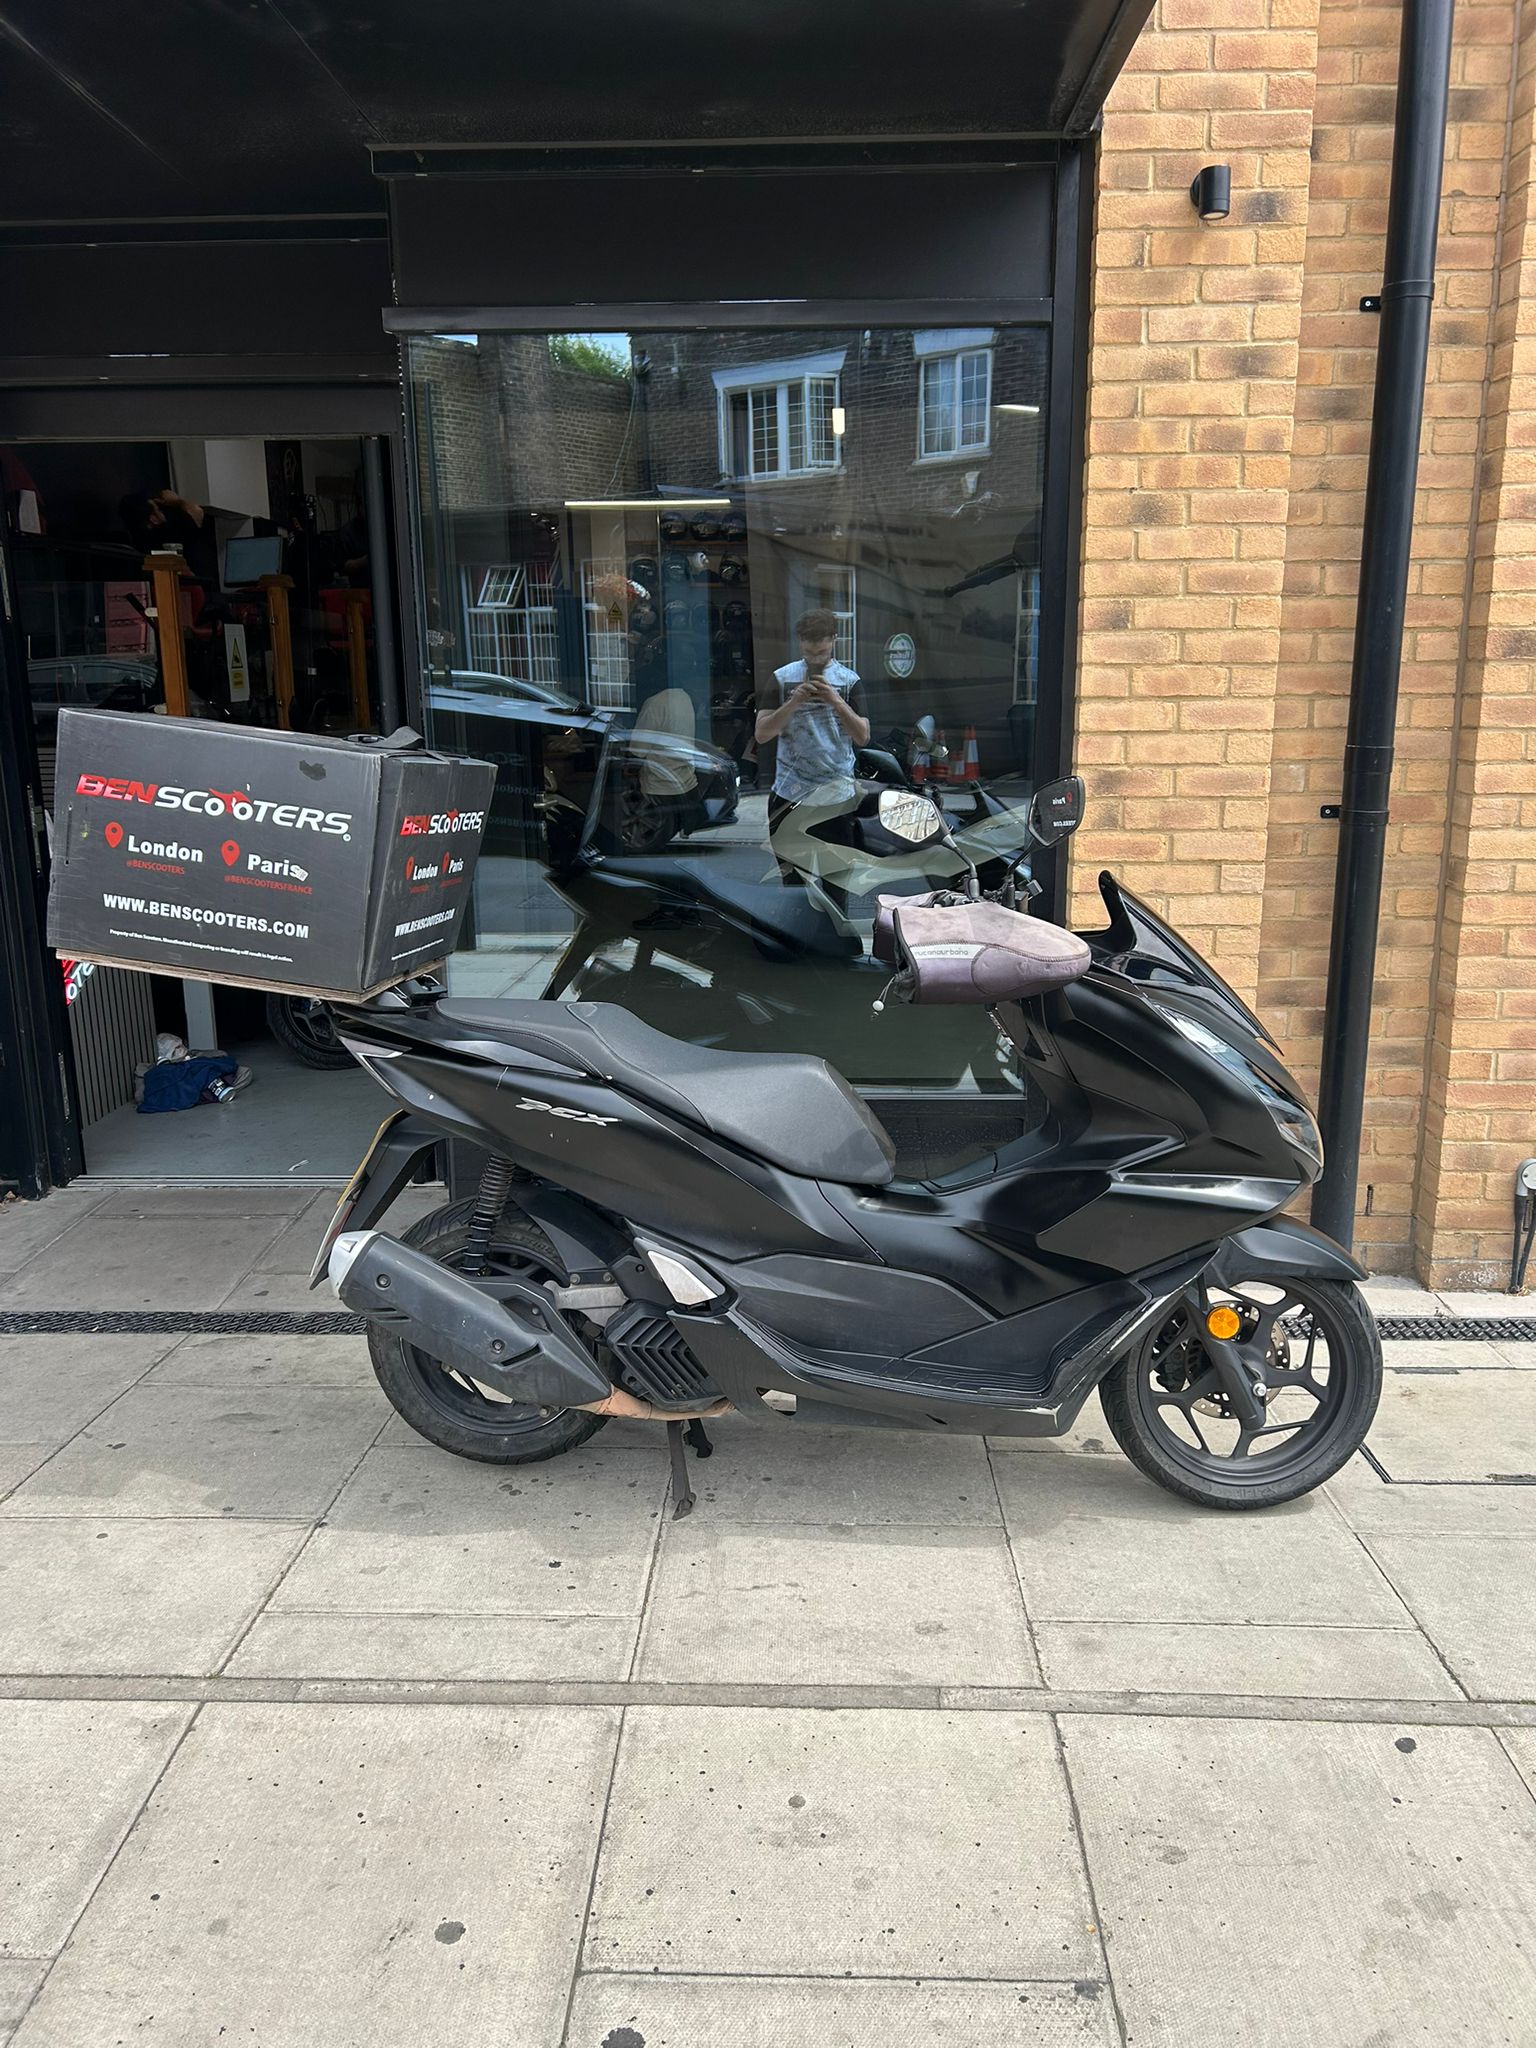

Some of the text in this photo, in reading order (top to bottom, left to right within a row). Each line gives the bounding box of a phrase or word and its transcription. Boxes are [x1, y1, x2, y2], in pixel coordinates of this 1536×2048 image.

[127, 834, 204, 863] London
[126, 859, 185, 875] @BENSCOOTERS
[247, 853, 303, 878] Paris
[412, 864, 438, 881] London
[448, 858, 464, 874] Paris
[224, 875, 313, 895] @BENSCOOTERSFRANCE
[103, 893, 309, 939] WWW.BENSCOOTERS.COM
[515, 1097, 622, 1127] PCX
